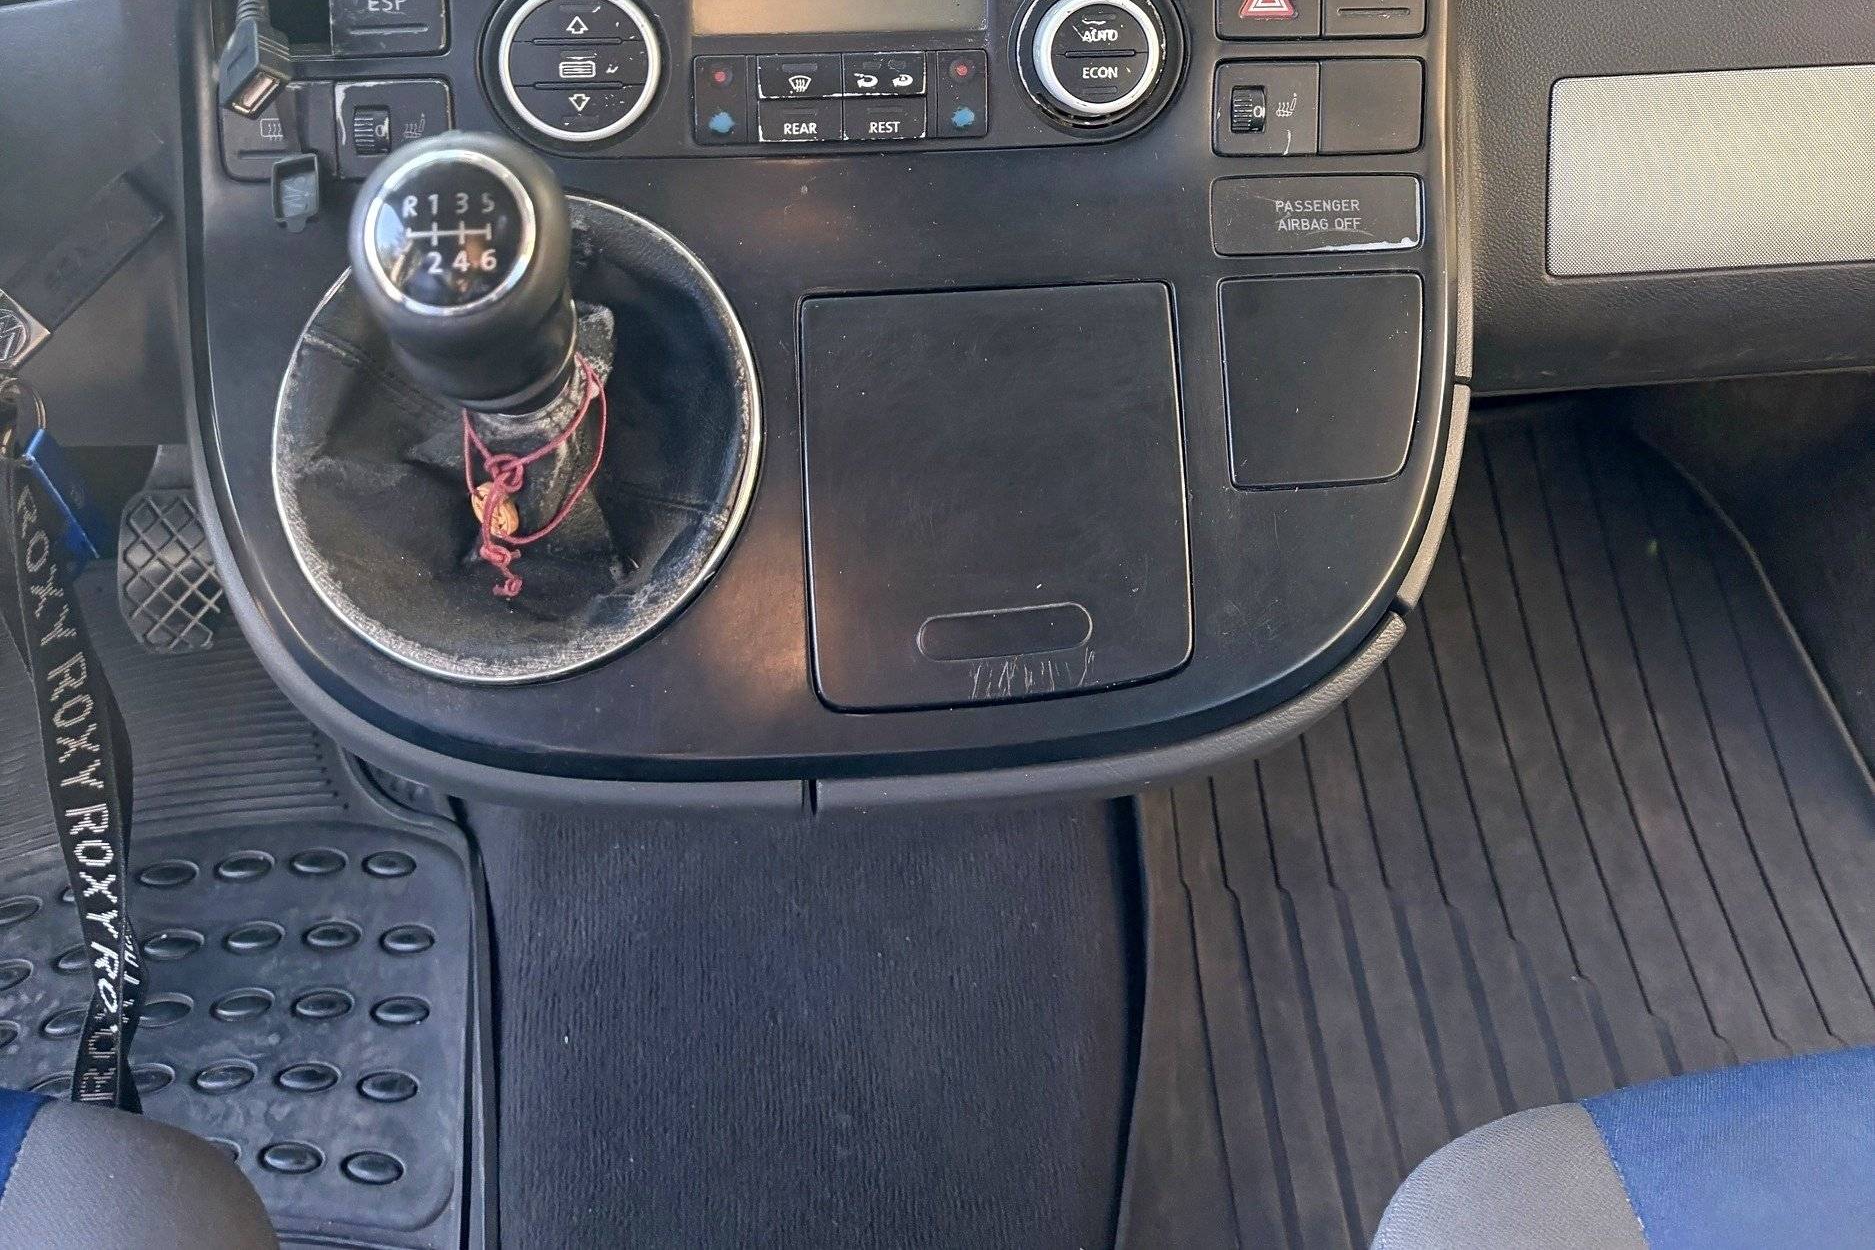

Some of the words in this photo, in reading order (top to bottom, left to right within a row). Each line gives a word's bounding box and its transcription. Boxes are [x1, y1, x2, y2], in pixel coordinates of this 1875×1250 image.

[1082, 29, 1119, 43] AUTO
[1082, 66, 1119, 80] ECON
[783, 121, 818, 136] REAR
[869, 120, 900, 134] REST
[402, 195, 419, 219] R
[428, 193, 439, 215] 1
[455, 192, 470, 214] 3
[481, 192, 496, 214] 5
[1275, 199, 1361, 212] PASSENGER
[1278, 218, 1329, 231] AIRBAG
[1334, 217, 1362, 230] OFF
[426, 251, 444, 275] 2
[453, 249, 471, 273] 4
[480, 249, 498, 272] 6
[17, 485, 78, 647] ROXY
[46, 651, 105, 790] ROXY
[64, 802, 119, 939] ROXY
